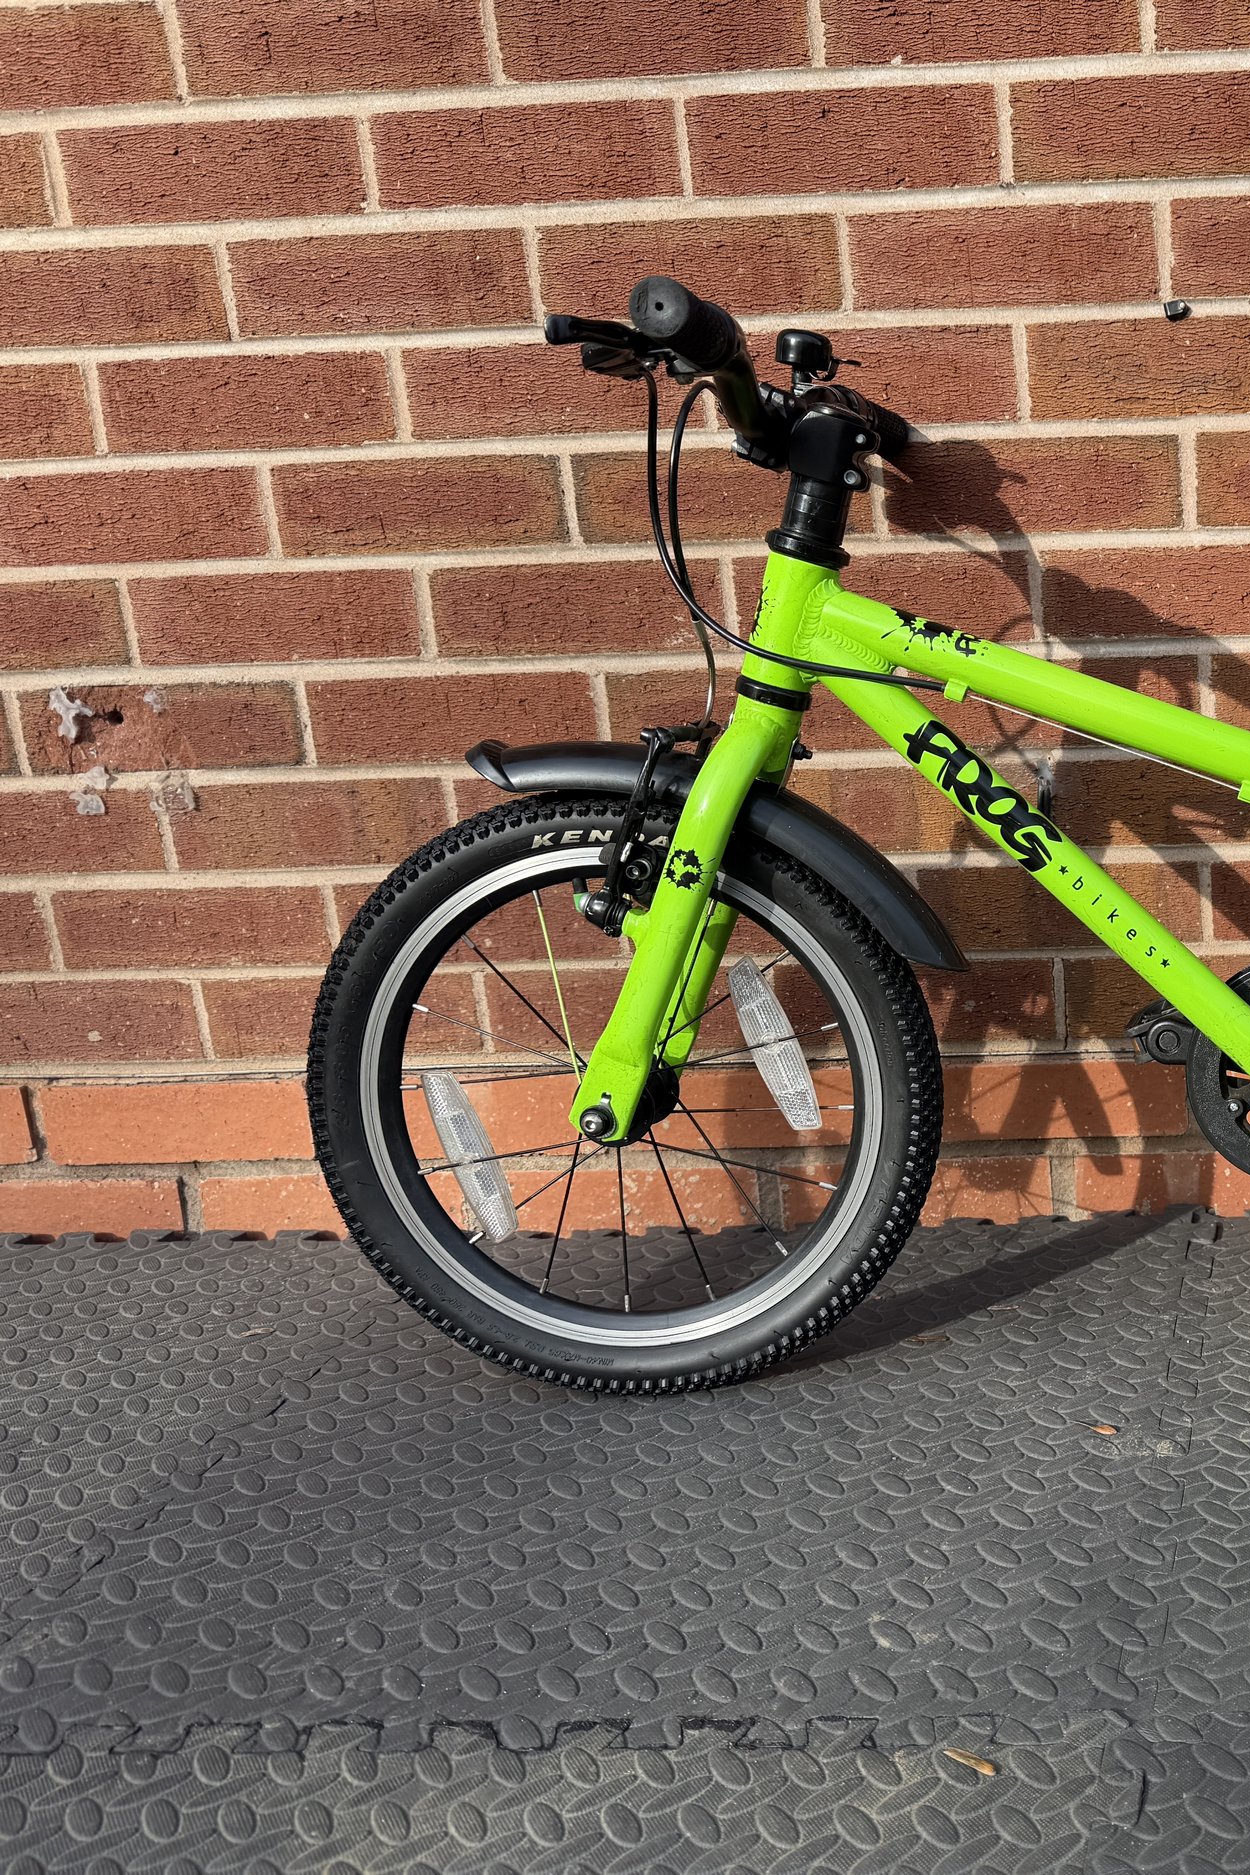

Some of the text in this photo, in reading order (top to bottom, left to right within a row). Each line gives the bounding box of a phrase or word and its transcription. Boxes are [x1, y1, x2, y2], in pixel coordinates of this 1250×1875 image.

[531, 829, 669, 849] KENA
[903, 719, 1157, 957] FROG bikes
